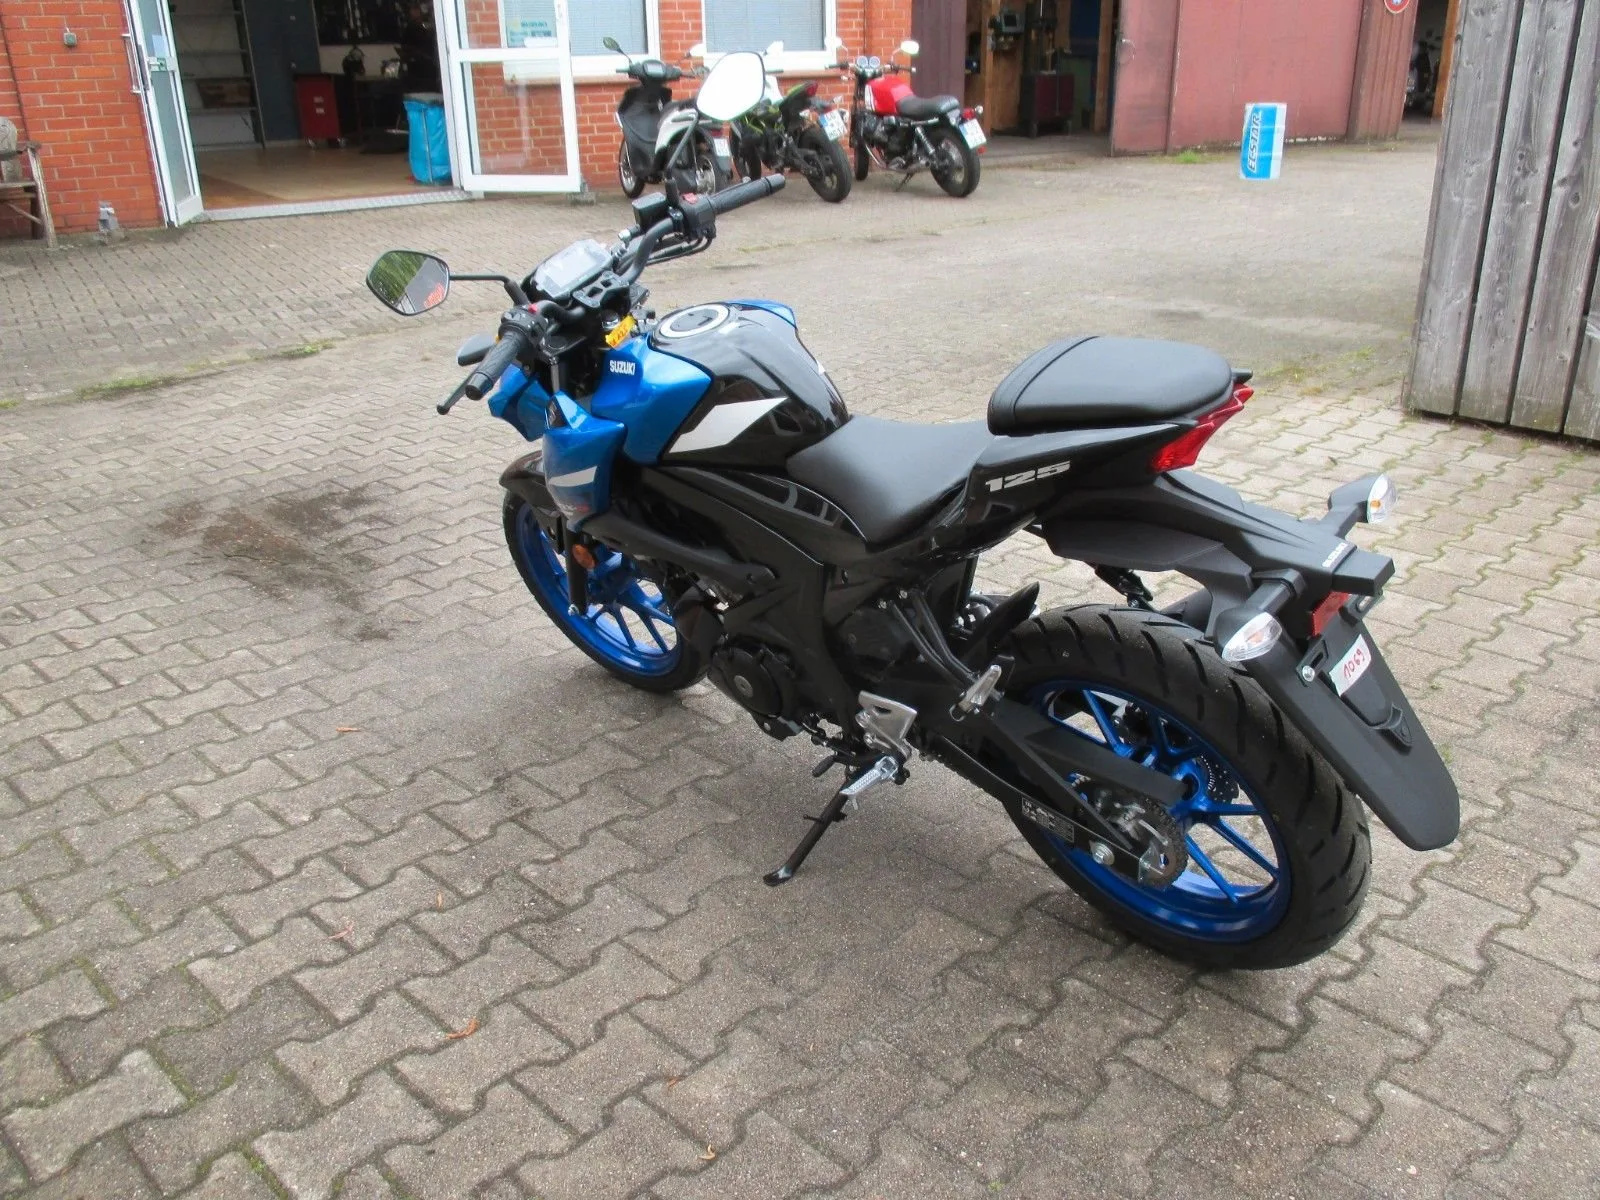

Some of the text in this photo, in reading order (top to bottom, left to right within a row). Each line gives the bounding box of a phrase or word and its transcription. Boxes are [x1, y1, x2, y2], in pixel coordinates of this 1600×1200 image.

[610, 360, 635, 375] SUZUKI
[985, 460, 1071, 492] 125
[1343, 648, 1365, 678] 1069
